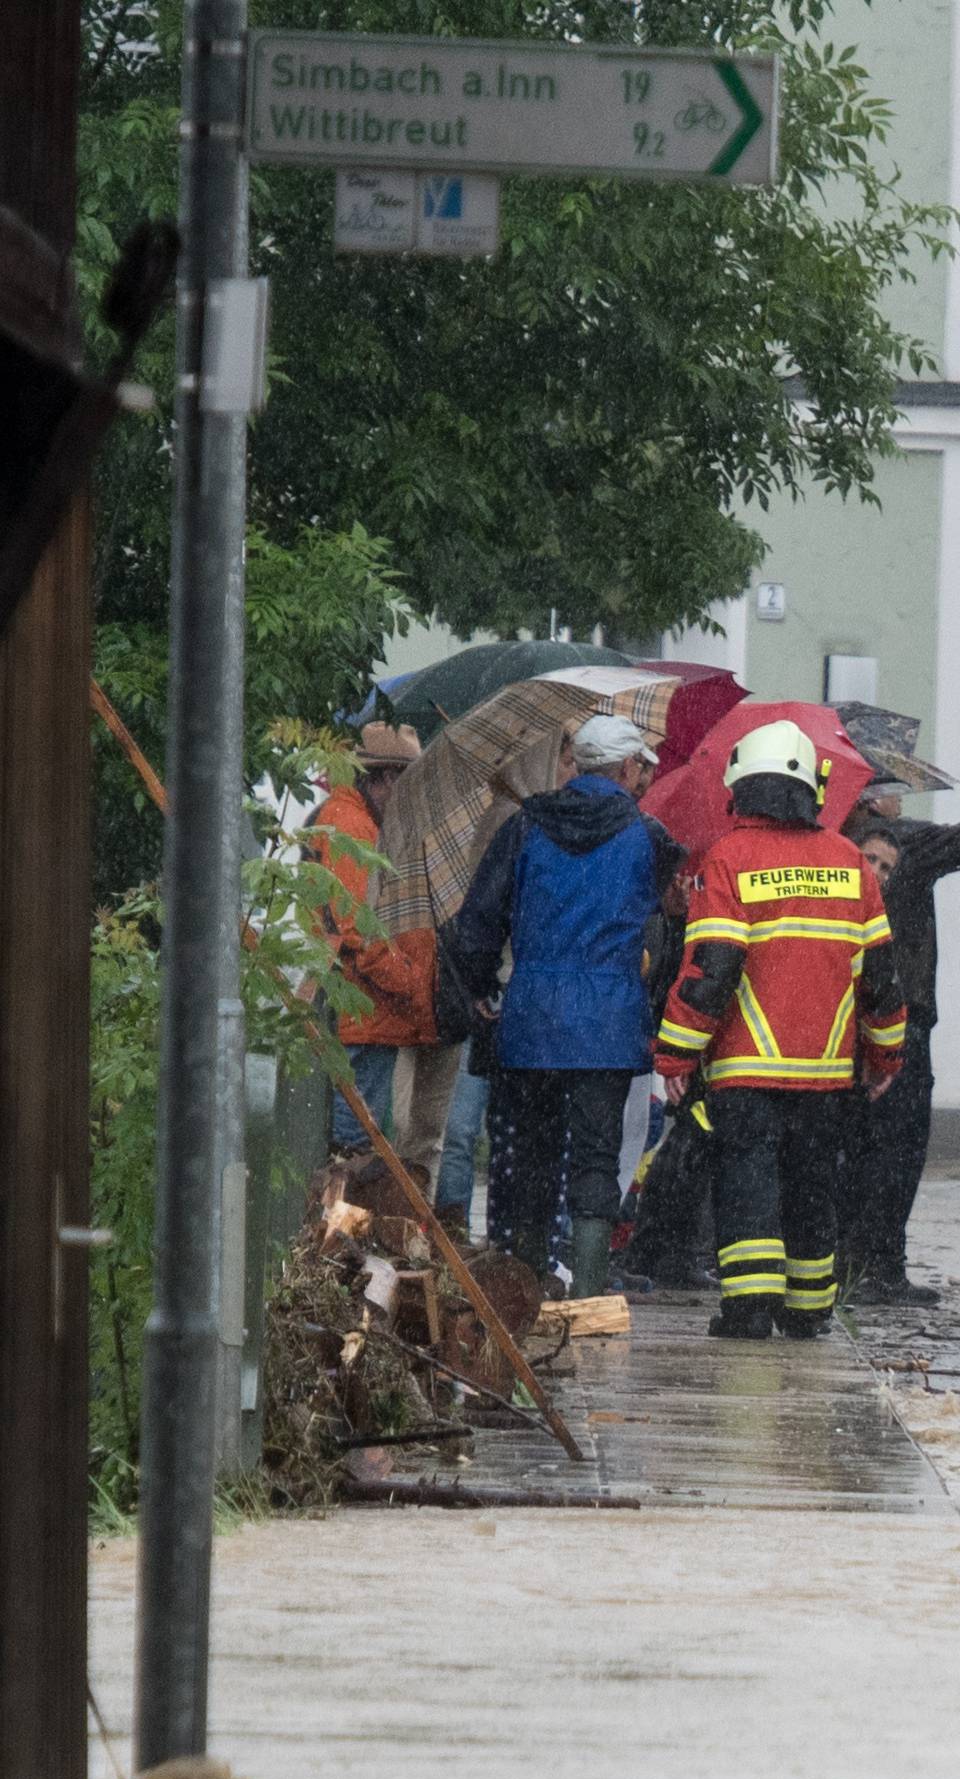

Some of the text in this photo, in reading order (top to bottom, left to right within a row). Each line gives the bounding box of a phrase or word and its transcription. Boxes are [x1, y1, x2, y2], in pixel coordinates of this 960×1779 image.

[271, 53, 441, 95] Simbach
[621, 69, 652, 104] 19
[270, 103, 468, 147] Wittibreut
[750, 868, 850, 887] FEUERWEHR
[775, 885, 829, 896] TRIFTERN
